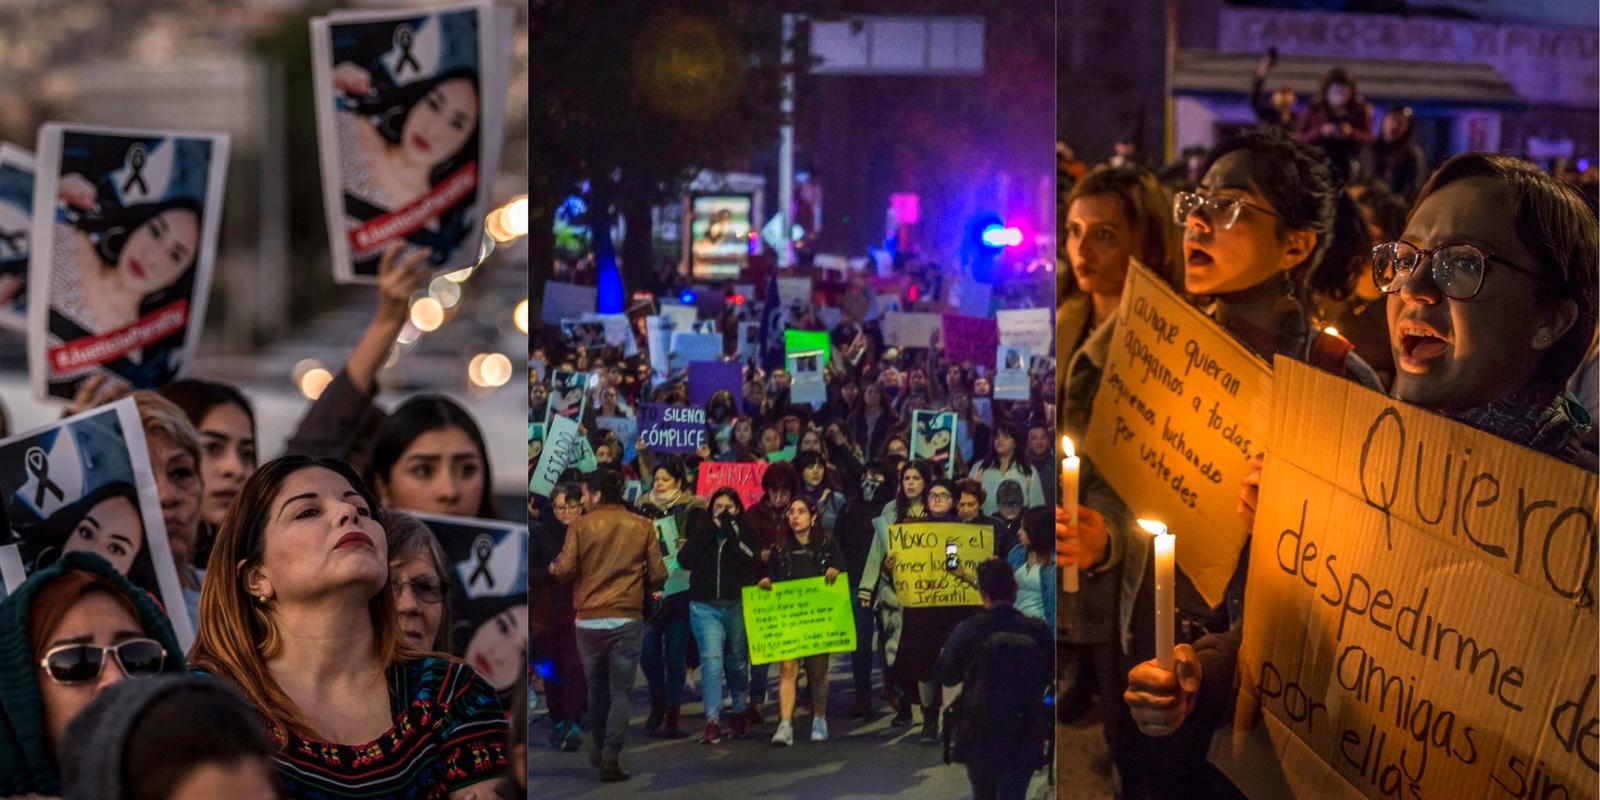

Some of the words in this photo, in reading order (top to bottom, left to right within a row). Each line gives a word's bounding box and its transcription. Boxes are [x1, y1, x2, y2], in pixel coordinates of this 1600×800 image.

[1134, 297, 1179, 344] aunque
[1184, 339, 1241, 397] quieran
[641, 423, 705, 449] CÓMPLICE
[1112, 416, 1136, 446] por
[1192, 396, 1202, 412] a
[1162, 416, 1222, 483] luchando
[1360, 406, 1597, 600] Quiero
[969, 529, 984, 549] el
[1277, 499, 1524, 713] despedirme
[1551, 674, 1599, 773] de
[1256, 662, 1327, 733] por
[1337, 645, 1478, 782] amigas
[1489, 756, 1569, 800] sin
